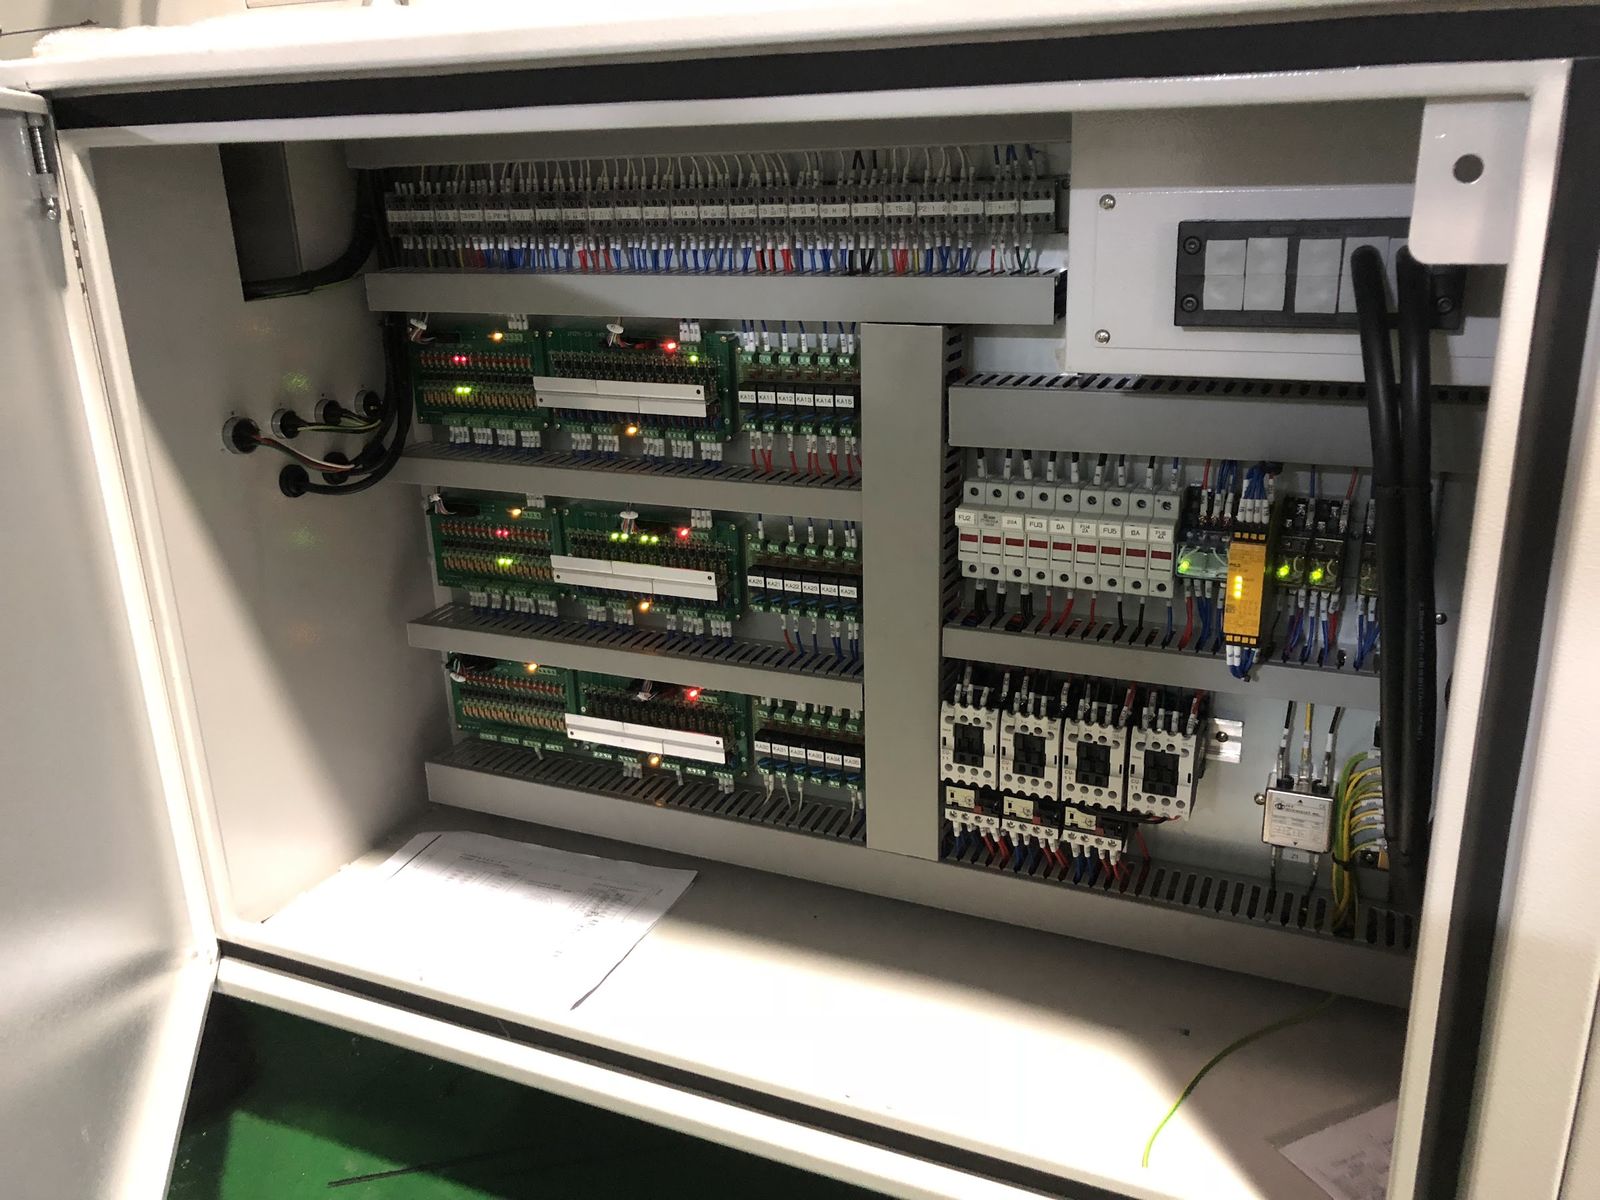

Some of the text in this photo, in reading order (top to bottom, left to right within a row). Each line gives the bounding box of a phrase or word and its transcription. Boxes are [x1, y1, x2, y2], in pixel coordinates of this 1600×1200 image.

[759, 394, 774, 402] KA11
[796, 396, 812, 404] KA13
[836, 398, 853, 406] KA15
[958, 514, 971, 522] FU2
[1029, 521, 1043, 529] FU3
